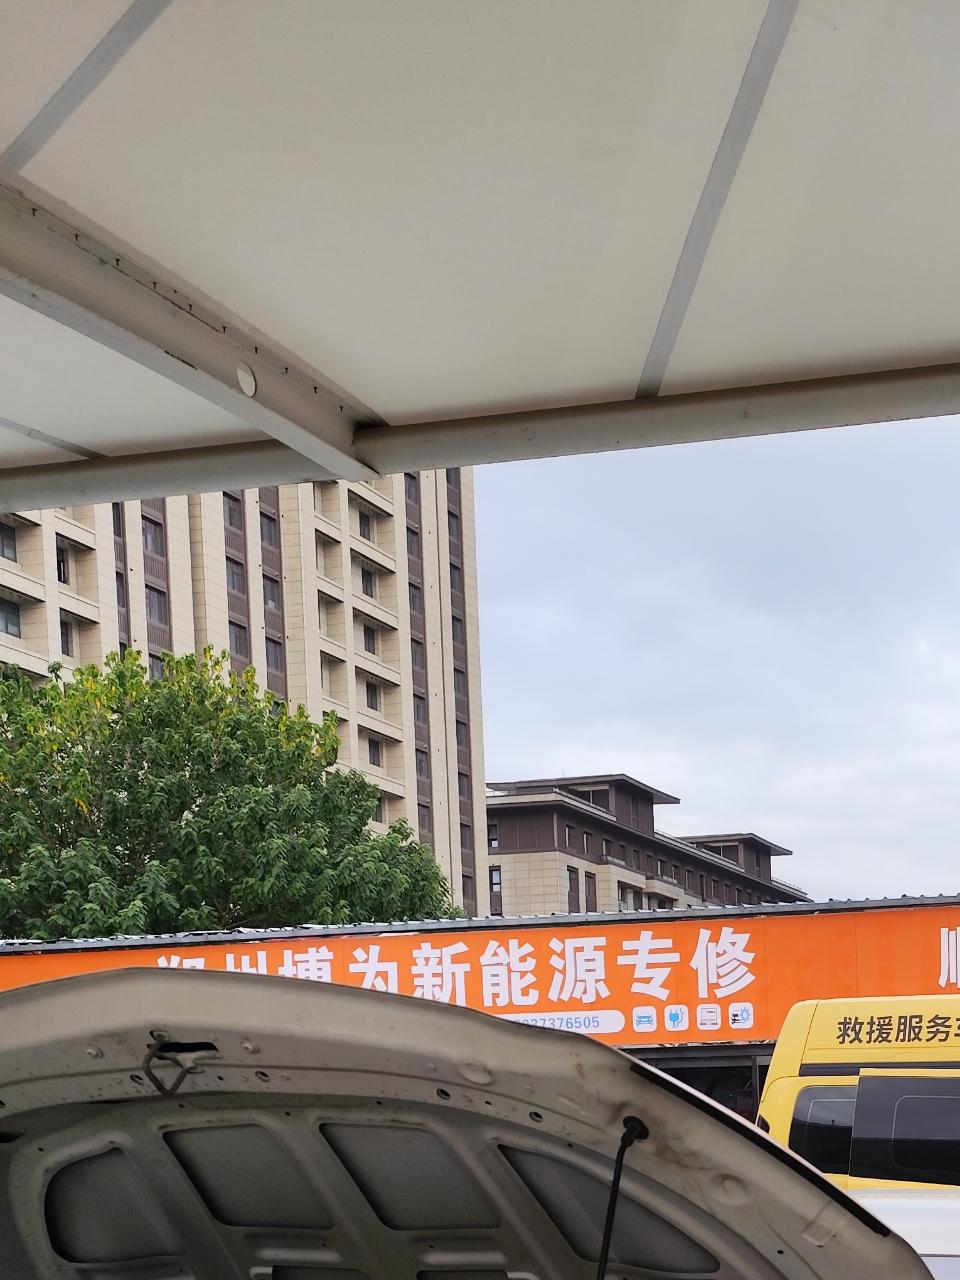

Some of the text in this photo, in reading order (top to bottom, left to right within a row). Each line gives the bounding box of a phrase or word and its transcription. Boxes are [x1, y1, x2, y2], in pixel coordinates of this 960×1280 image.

[157, 926, 757, 1007] 博为新能源专修
